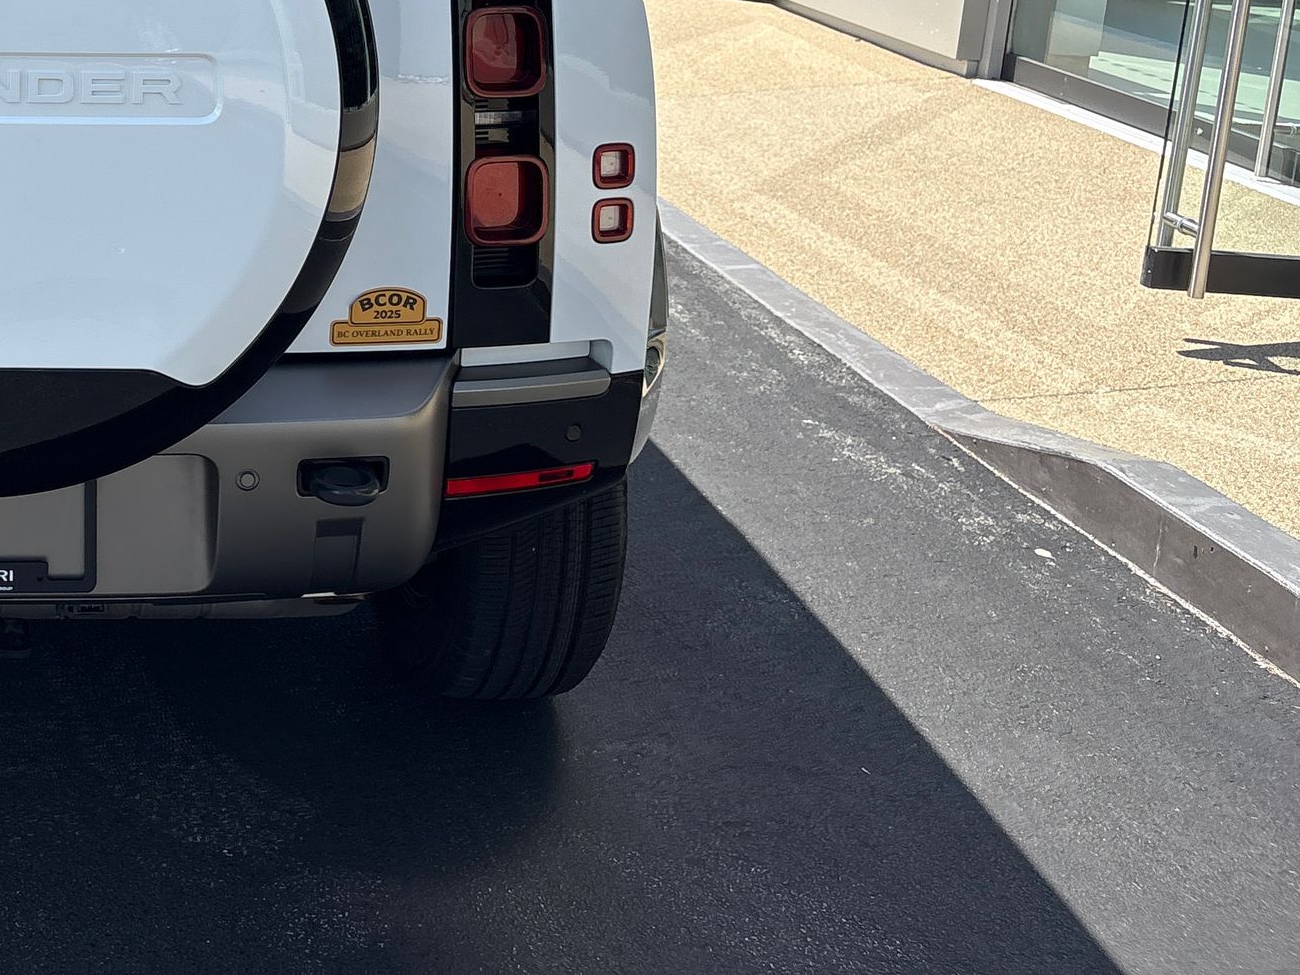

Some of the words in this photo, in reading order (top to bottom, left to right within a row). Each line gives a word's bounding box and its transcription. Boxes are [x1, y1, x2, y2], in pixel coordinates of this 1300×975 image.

[358, 292, 418, 313] BCOR
[373, 309, 402, 320] 2025
[336, 329, 350, 339] BC
[351, 328, 404, 338] OVERLAND
[405, 326, 436, 337] RALLY
